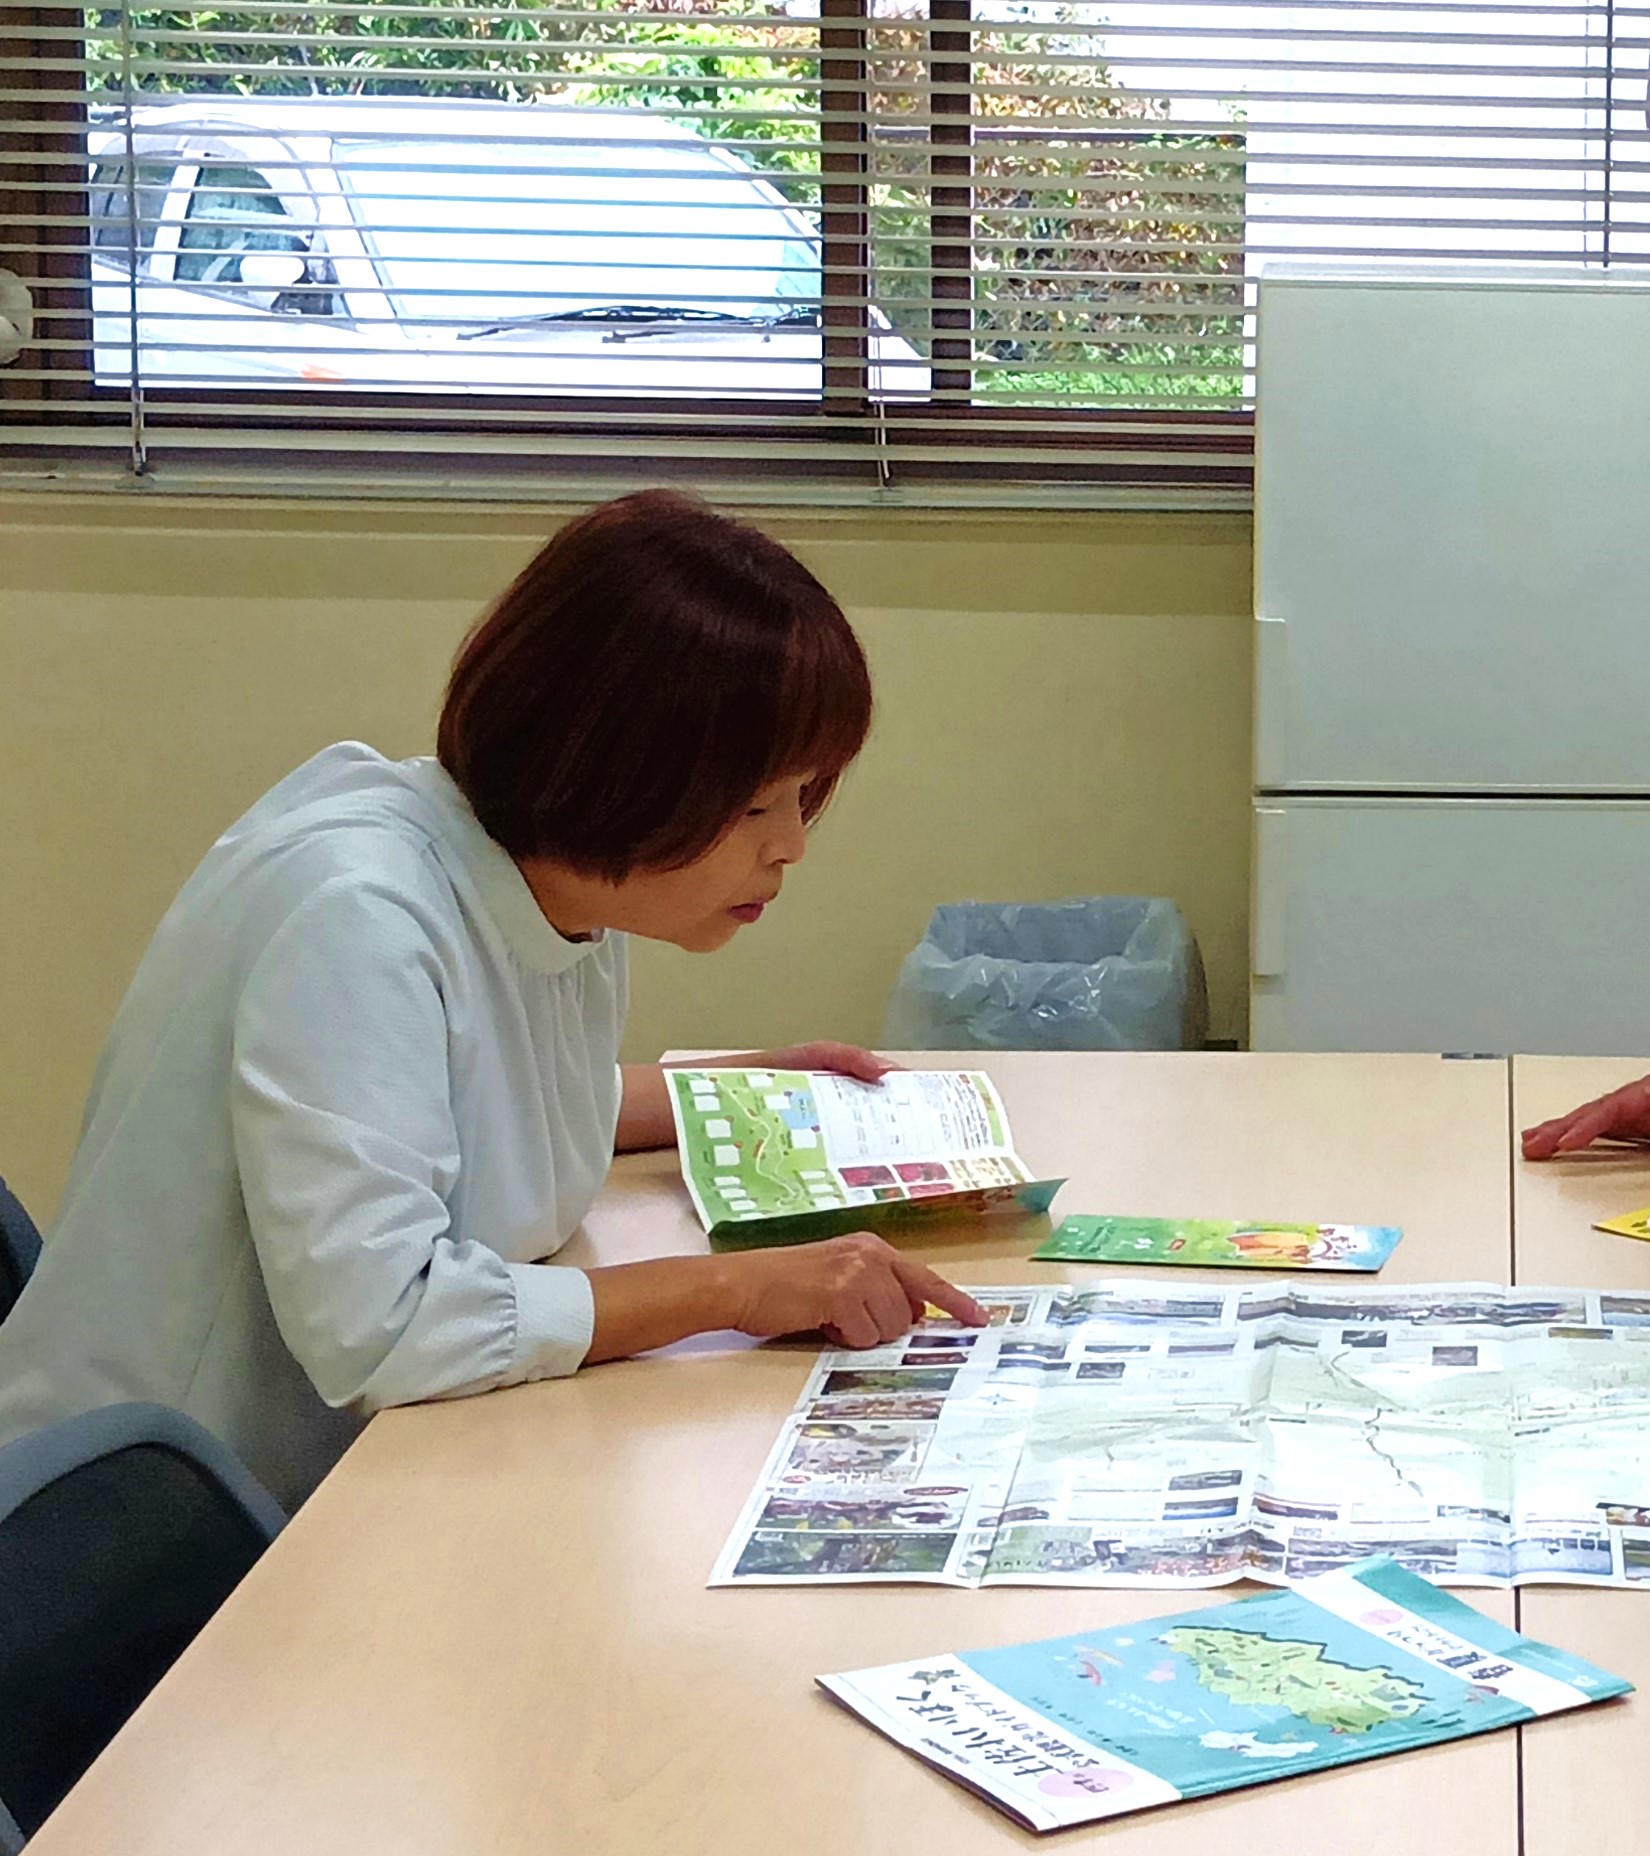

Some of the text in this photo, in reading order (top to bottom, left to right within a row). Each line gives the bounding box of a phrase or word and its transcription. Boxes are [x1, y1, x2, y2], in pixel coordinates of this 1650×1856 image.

[896, 1690, 1064, 1777] 土佐れいほく
